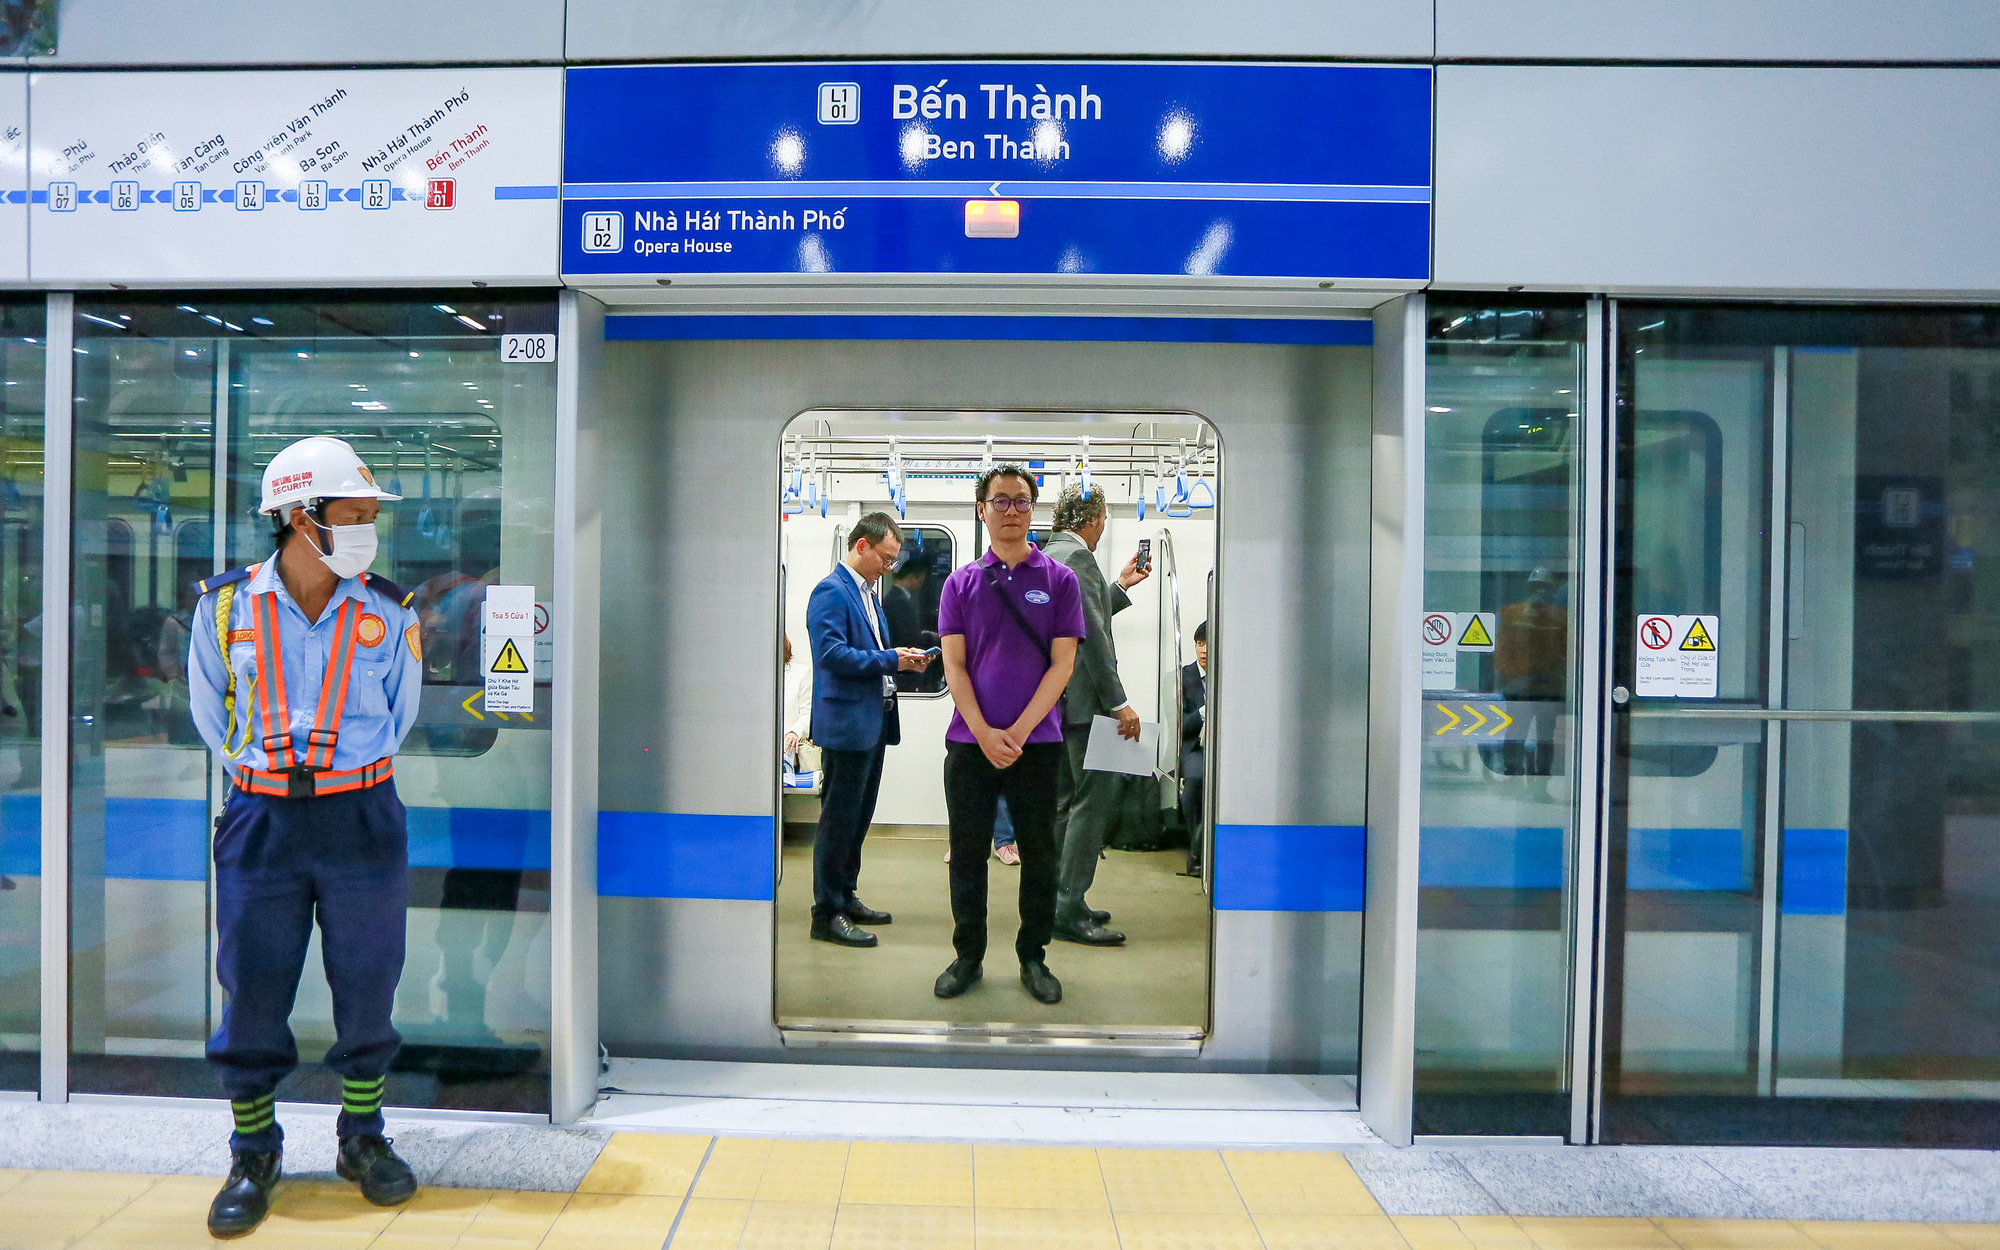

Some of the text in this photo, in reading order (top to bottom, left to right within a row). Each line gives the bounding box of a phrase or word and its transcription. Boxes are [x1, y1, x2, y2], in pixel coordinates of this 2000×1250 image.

[831, 89, 847, 102] L1
[893, 79, 1102, 120] Bến Thành
[831, 105, 847, 118] 01
[233, 150, 264, 174] Công
[286, 115, 311, 134] Văn
[309, 88, 347, 117] Thánh
[361, 86, 469, 171] Nhà Hát Thành Phố
[293, 130, 313, 146] Park
[62, 138, 88, 160] Phú
[171, 156, 195, 174] Tân
[194, 134, 225, 158] Cảng
[383, 135, 432, 173] Opera House
[425, 124, 487, 171] Bến Thành
[924, 134, 975, 160] Ben
[78, 151, 96, 165] Phu
[194, 147, 229, 174] Tan Cang
[299, 140, 340, 172] Ba Son
[321, 150, 349, 172] Ba Son
[447, 138, 490, 171] Ben Thanh
[108, 152, 138, 174] Thảo
[57, 185, 68, 196] L1
[119, 184, 131, 195] L1
[182, 185, 193, 196] L1
[244, 184, 256, 195] L1
[307, 184, 319, 195] L1
[370, 183, 382, 194] L1
[434, 182, 446, 194] L1
[55, 197, 69, 209] 07
[118, 197, 131, 207] 06
[181, 197, 194, 208] 05
[243, 197, 256, 207] 04
[306, 196, 319, 207] 03
[369, 195, 382, 206] 02
[434, 194, 446, 206] 01
[595, 218, 611, 231] L1
[634, 206, 848, 231] Nhà Hát Thành Phố
[593, 234, 611, 247] 02
[634, 239, 732, 257] Opera House
[508, 338, 545, 358] 2-08
[272, 480, 312, 495] SECURITY
